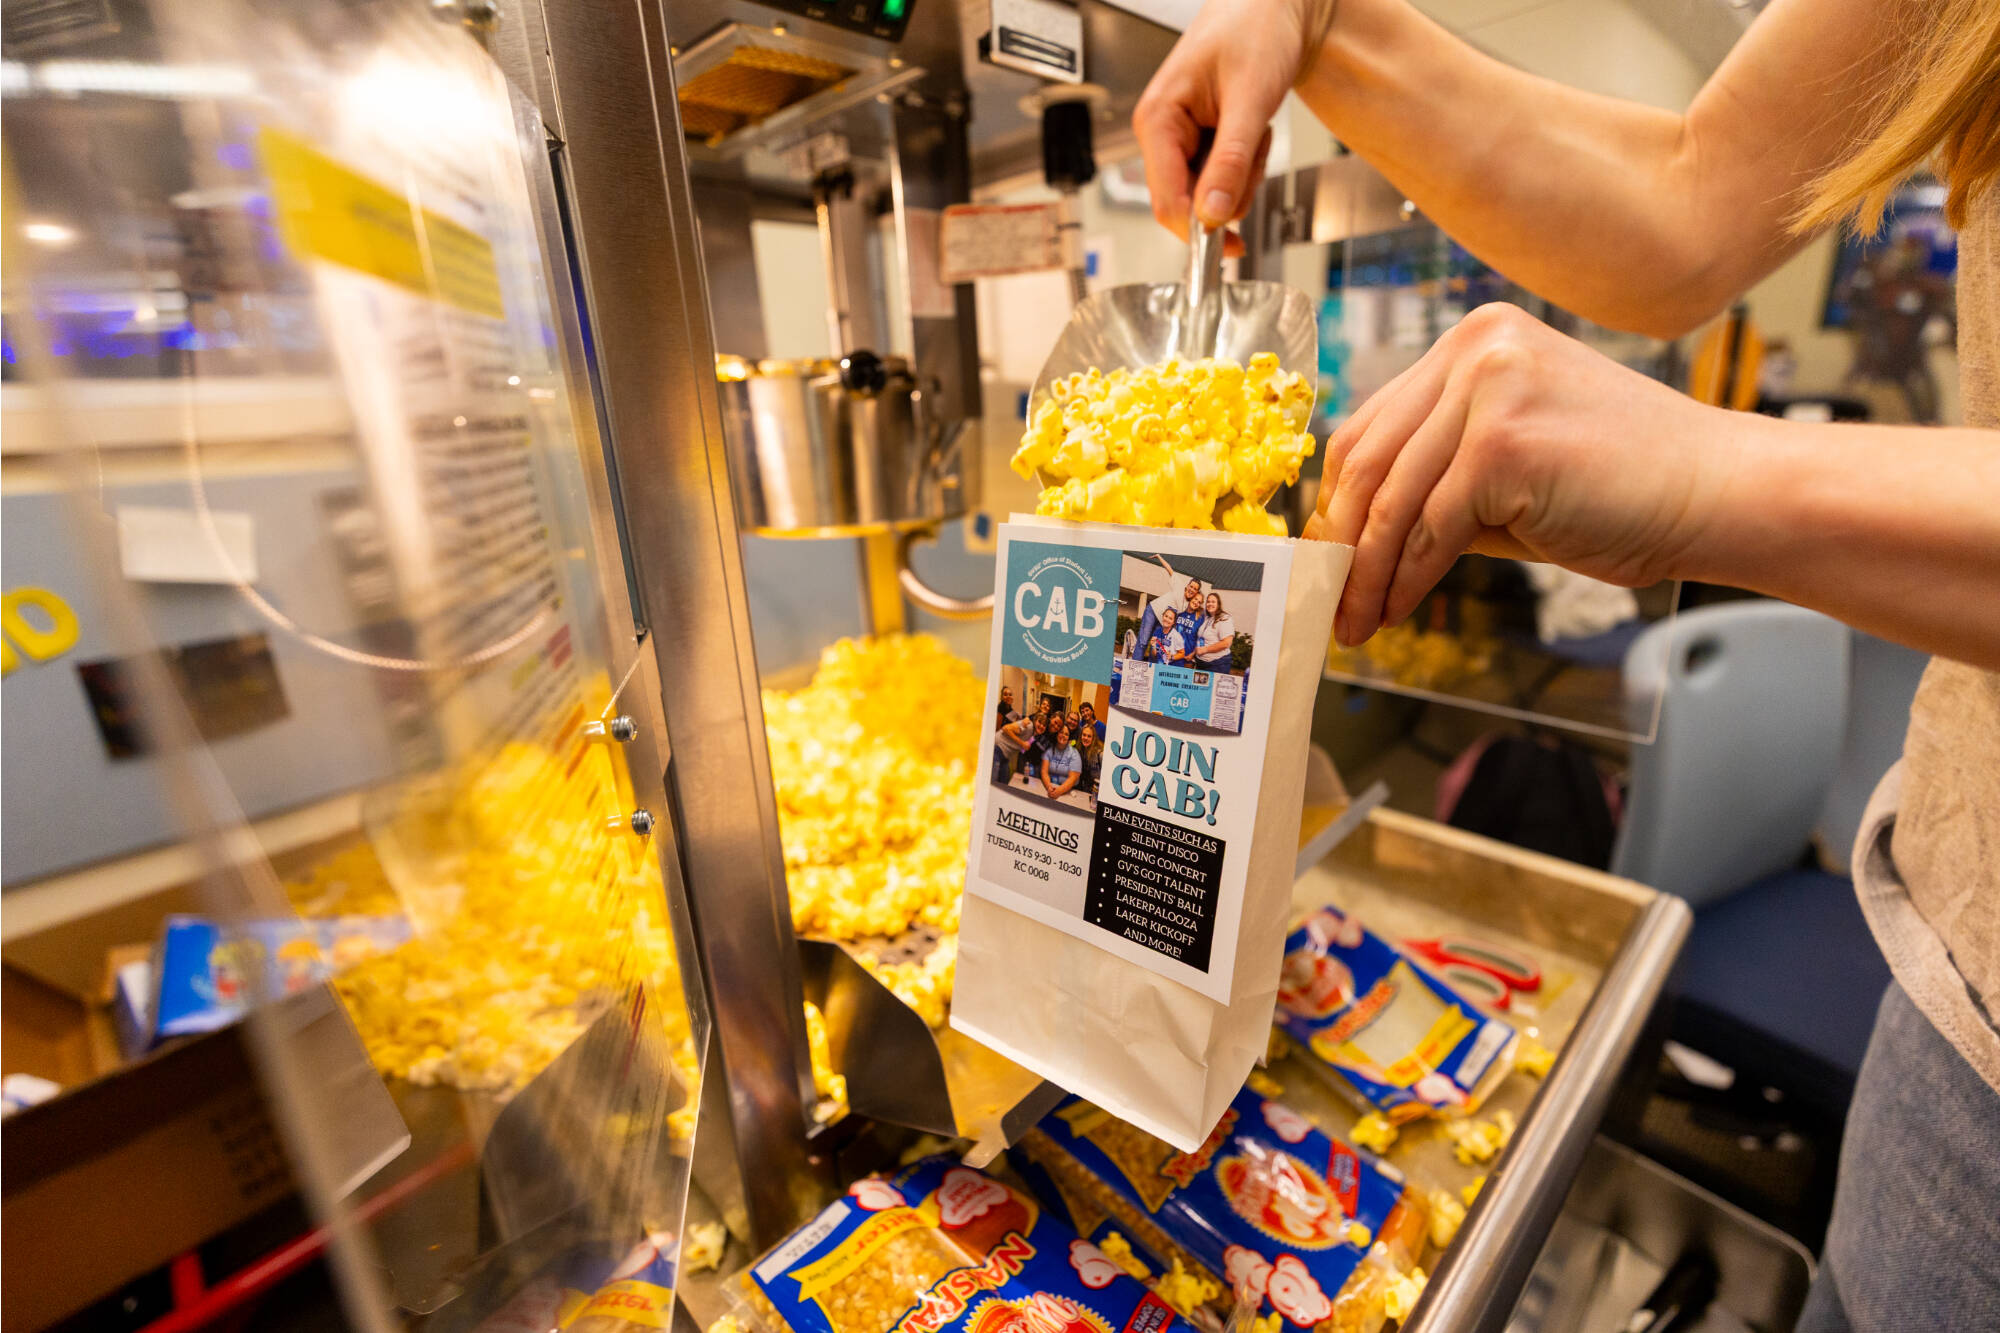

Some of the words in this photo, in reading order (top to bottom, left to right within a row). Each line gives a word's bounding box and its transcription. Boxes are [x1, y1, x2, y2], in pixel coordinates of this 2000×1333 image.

[0, 586, 79, 675] D
[1014, 581, 1105, 638] CAB
[1169, 696, 1189, 708] CAB
[1110, 725, 1220, 784] JOIN
[1111, 764, 1220, 826] CAB!
[997, 807, 1079, 851] MEETINGS
[1103, 806, 1130, 824] PLAN
[1132, 815, 1170, 837] EVENTS
[1172, 826, 1200, 847] SUCH
[1202, 838, 1218, 852] AS
[1131, 832, 1166, 850] SILENT
[1168, 843, 1199, 863] DISCO
[987, 833, 1033, 858] TUESDAYS
[1034, 851, 1052, 866] 9:30
[1058, 860, 1082, 877] 10:30
[1013, 859, 1027, 873] KC
[1028, 865, 1049, 881] 0008
[1120, 844, 1156, 865] SPRING
[1157, 857, 1207, 883] CONCERT
[1114, 874, 1176, 905] PRESIDENTS'
[1177, 897, 1204, 918] BALL
[1117, 859, 1140, 876] GV'S
[1140, 868, 1163, 885] GOT
[1163, 875, 1206, 900] TALENT
[1115, 906, 1148, 928] LAKER
[1150, 920, 1196, 946] KICKOFF
[1116, 890, 1198, 932] LAKERPALOOZA
[1123, 927, 1147, 943] AND
[1148, 936, 1182, 959] MORE!
